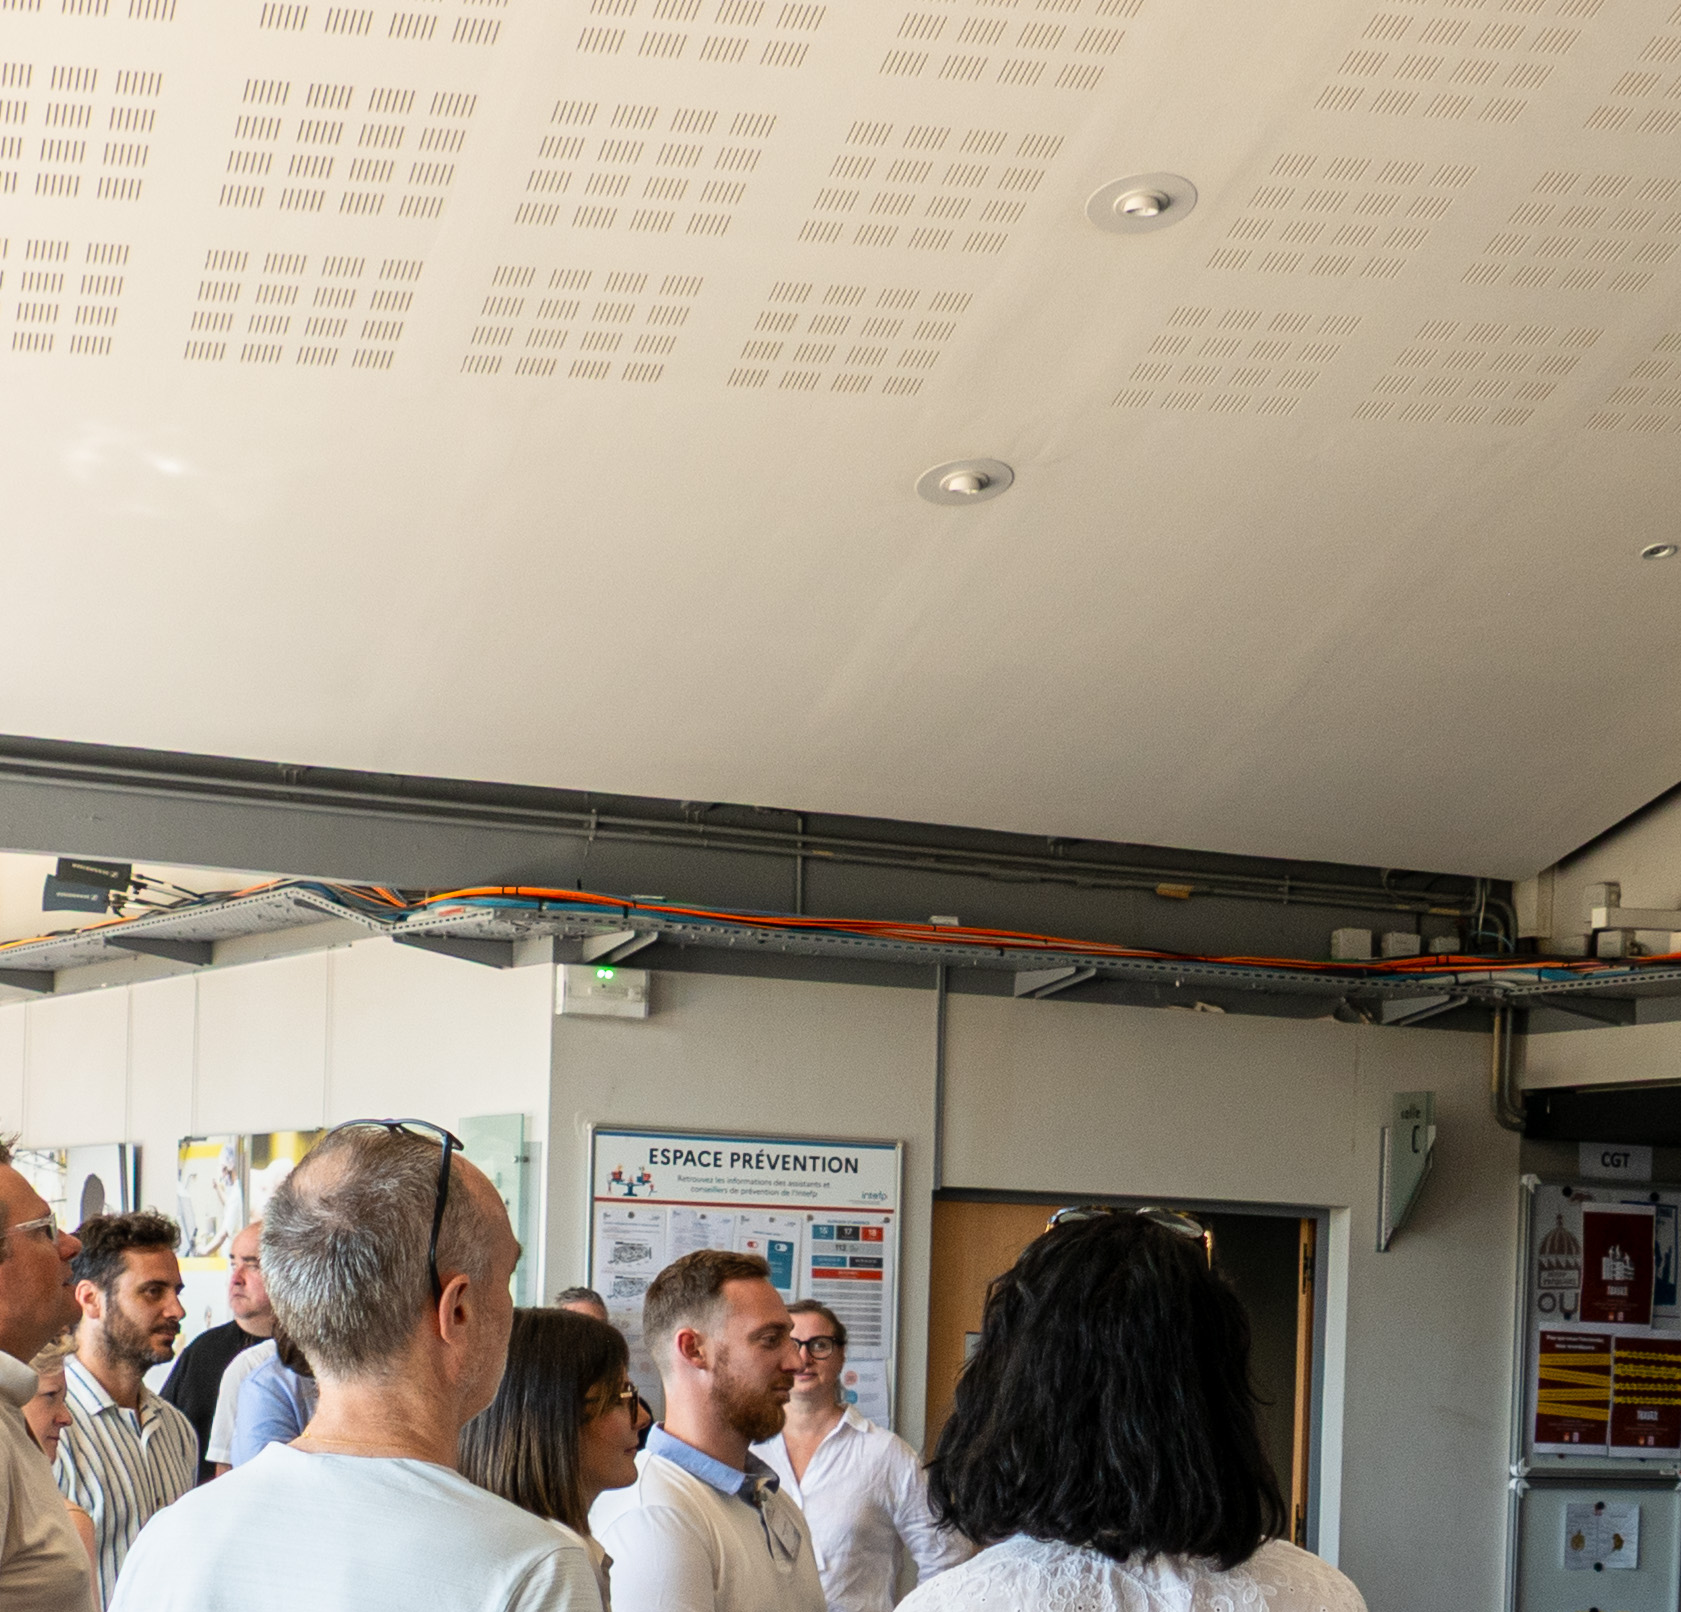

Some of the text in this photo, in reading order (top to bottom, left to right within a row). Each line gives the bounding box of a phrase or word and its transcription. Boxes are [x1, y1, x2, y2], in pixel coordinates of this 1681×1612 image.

[648, 1148, 859, 1174] ESPACE PRÉVENTION
[1601, 1151, 1630, 1168] CGT
[677, 1175, 713, 1185] Retrouvez
[715, 1176, 725, 1184] les
[727, 1177, 771, 1186] informations
[773, 1179, 786, 1187] des
[788, 1180, 821, 1188] assistants
[690, 1185, 727, 1194] conseillers
[741, 1187, 779, 1197] prévention
